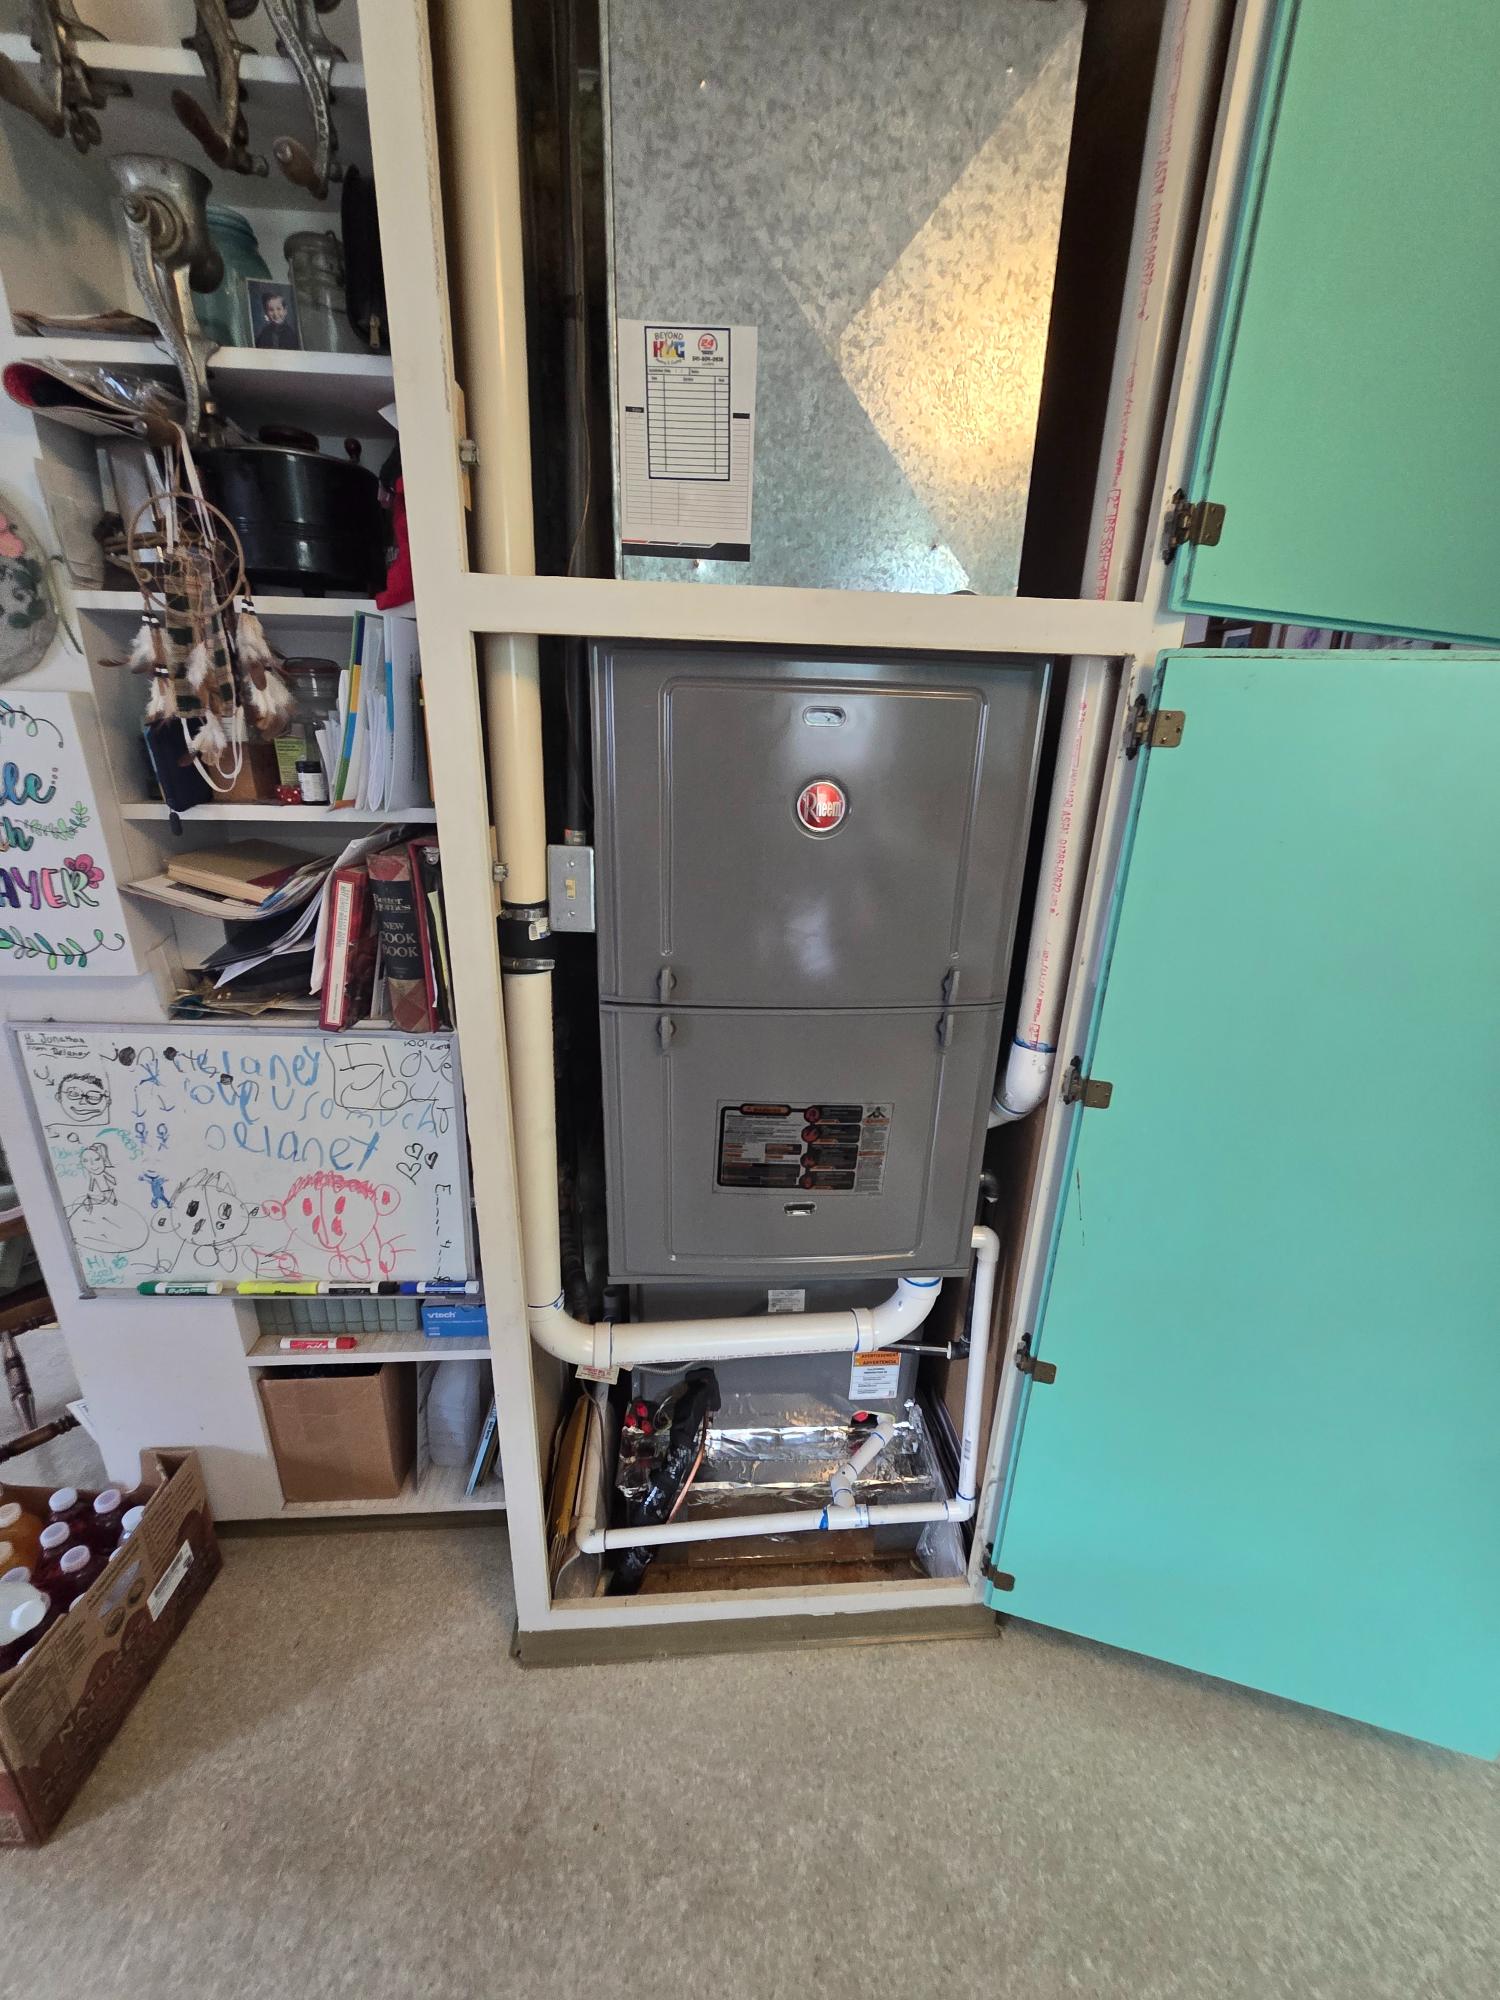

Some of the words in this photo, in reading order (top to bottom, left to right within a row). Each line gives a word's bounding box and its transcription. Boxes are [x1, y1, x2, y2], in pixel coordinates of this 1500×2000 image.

[654, 332, 684, 340] BEYOND
[801, 787, 842, 824] Rheem
[0, 867, 100, 910] AYER
[383, 921, 405, 931] NEW
[380, 930, 416, 944] COOK
[382, 945, 418, 958] BOOK
